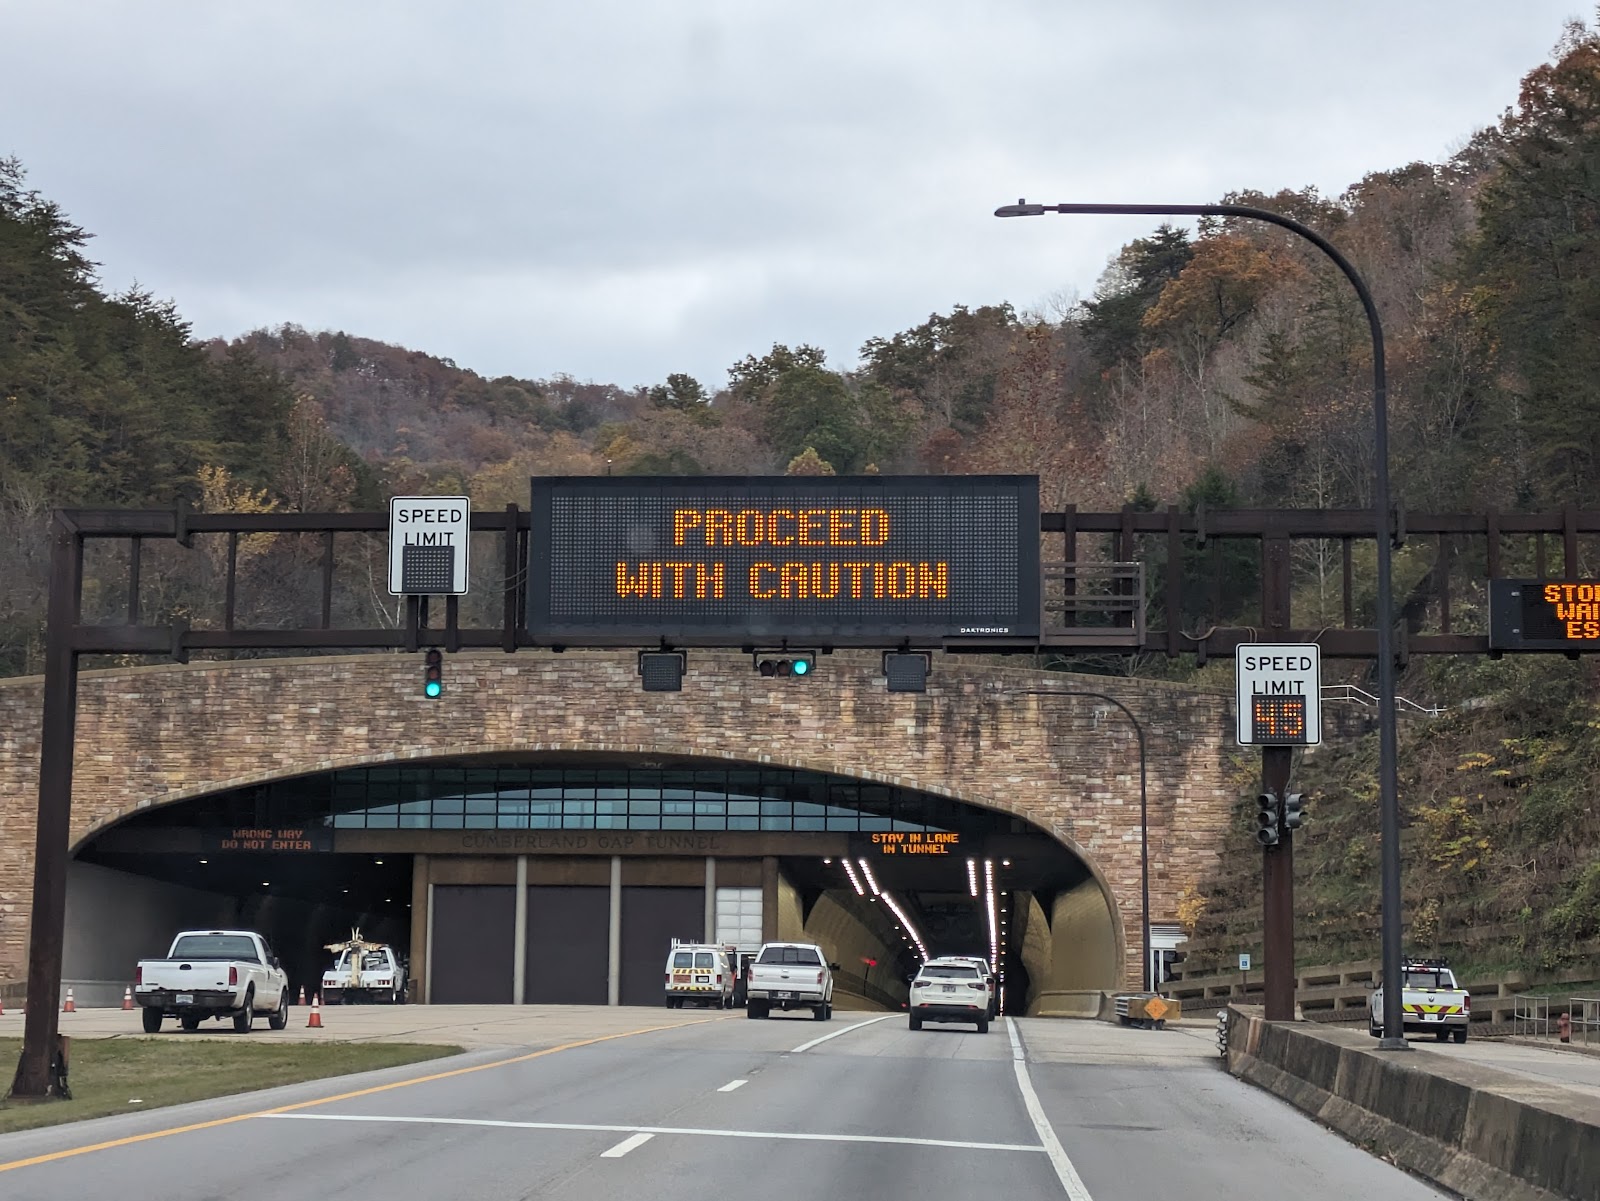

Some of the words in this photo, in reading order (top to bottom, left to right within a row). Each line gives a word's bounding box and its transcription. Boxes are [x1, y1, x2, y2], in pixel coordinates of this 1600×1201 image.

[398, 509, 462, 523] SPEED
[674, 509, 890, 546] PROCEED
[405, 532, 454, 546] LIMIT
[616, 562, 725, 599] WITH
[749, 562, 948, 599] CAUTION
[1245, 656, 1312, 671] SPEED
[1252, 681, 1304, 694] LIMIT
[1255, 703, 1302, 735] 45
[232, 829, 273, 839] WRONG
[278, 829, 304, 839] WAY
[871, 833, 905, 843] STAY
[909, 833, 922, 843] IN
[926, 833, 959, 843] LANE
[221, 840, 239, 849] DO
[243, 840, 267, 849] NOT
[272, 840, 312, 850] ENTER
[462, 835, 589, 849] CUMBERLAND
[599, 836, 634, 849] GAP
[646, 836, 720, 850] TUNNEL
[883, 843, 896, 854] IN
[901, 843, 949, 854] TUNNEL
